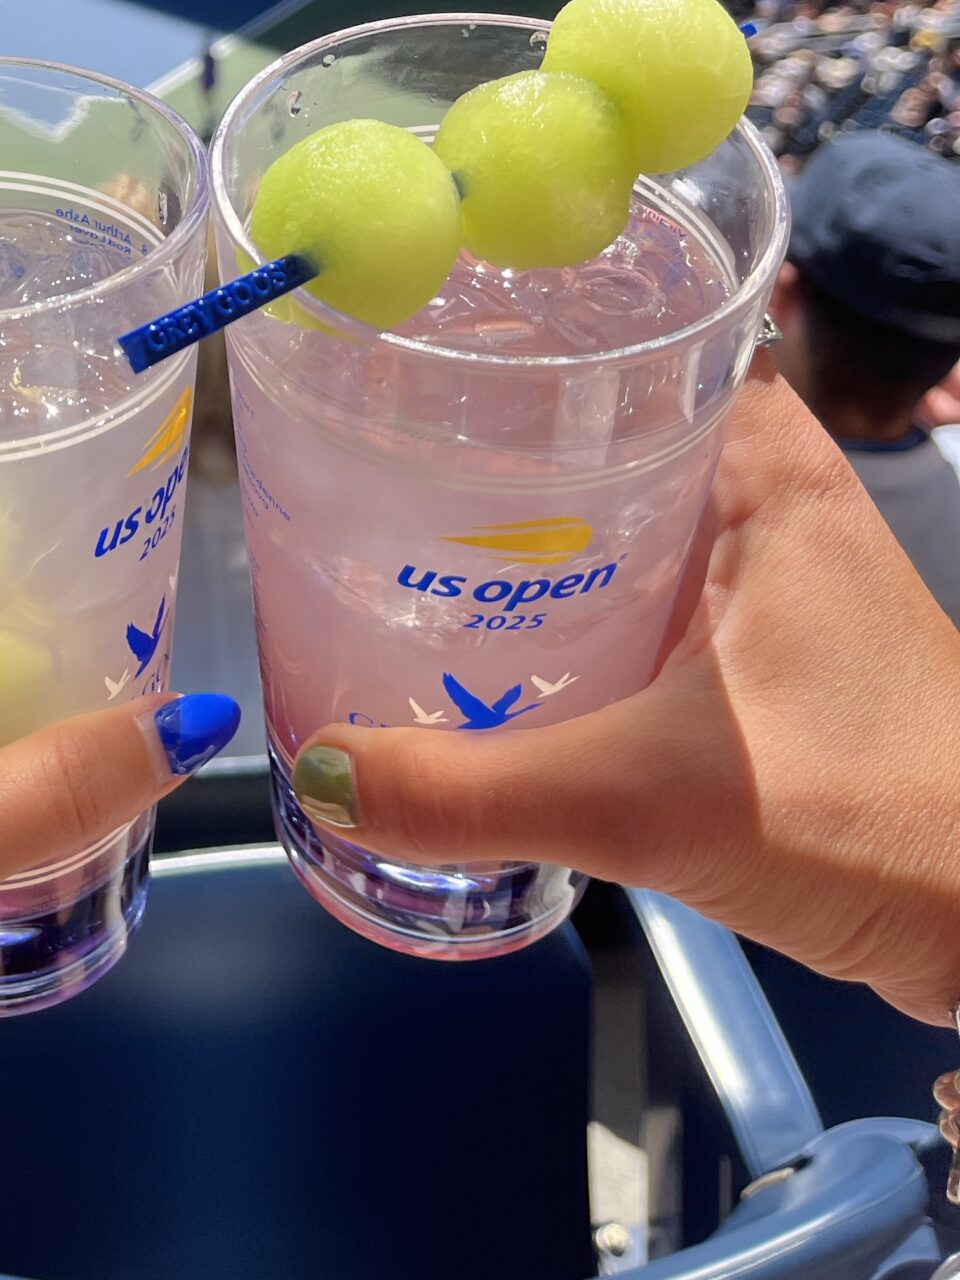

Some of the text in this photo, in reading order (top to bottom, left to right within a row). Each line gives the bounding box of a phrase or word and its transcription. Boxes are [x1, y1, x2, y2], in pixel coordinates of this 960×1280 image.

[95, 504, 143, 558] us
[145, 445, 189, 525] ope
[139, 503, 178, 562] 2025
[396, 560, 617, 612] us open
[462, 613, 547, 631] 2025
